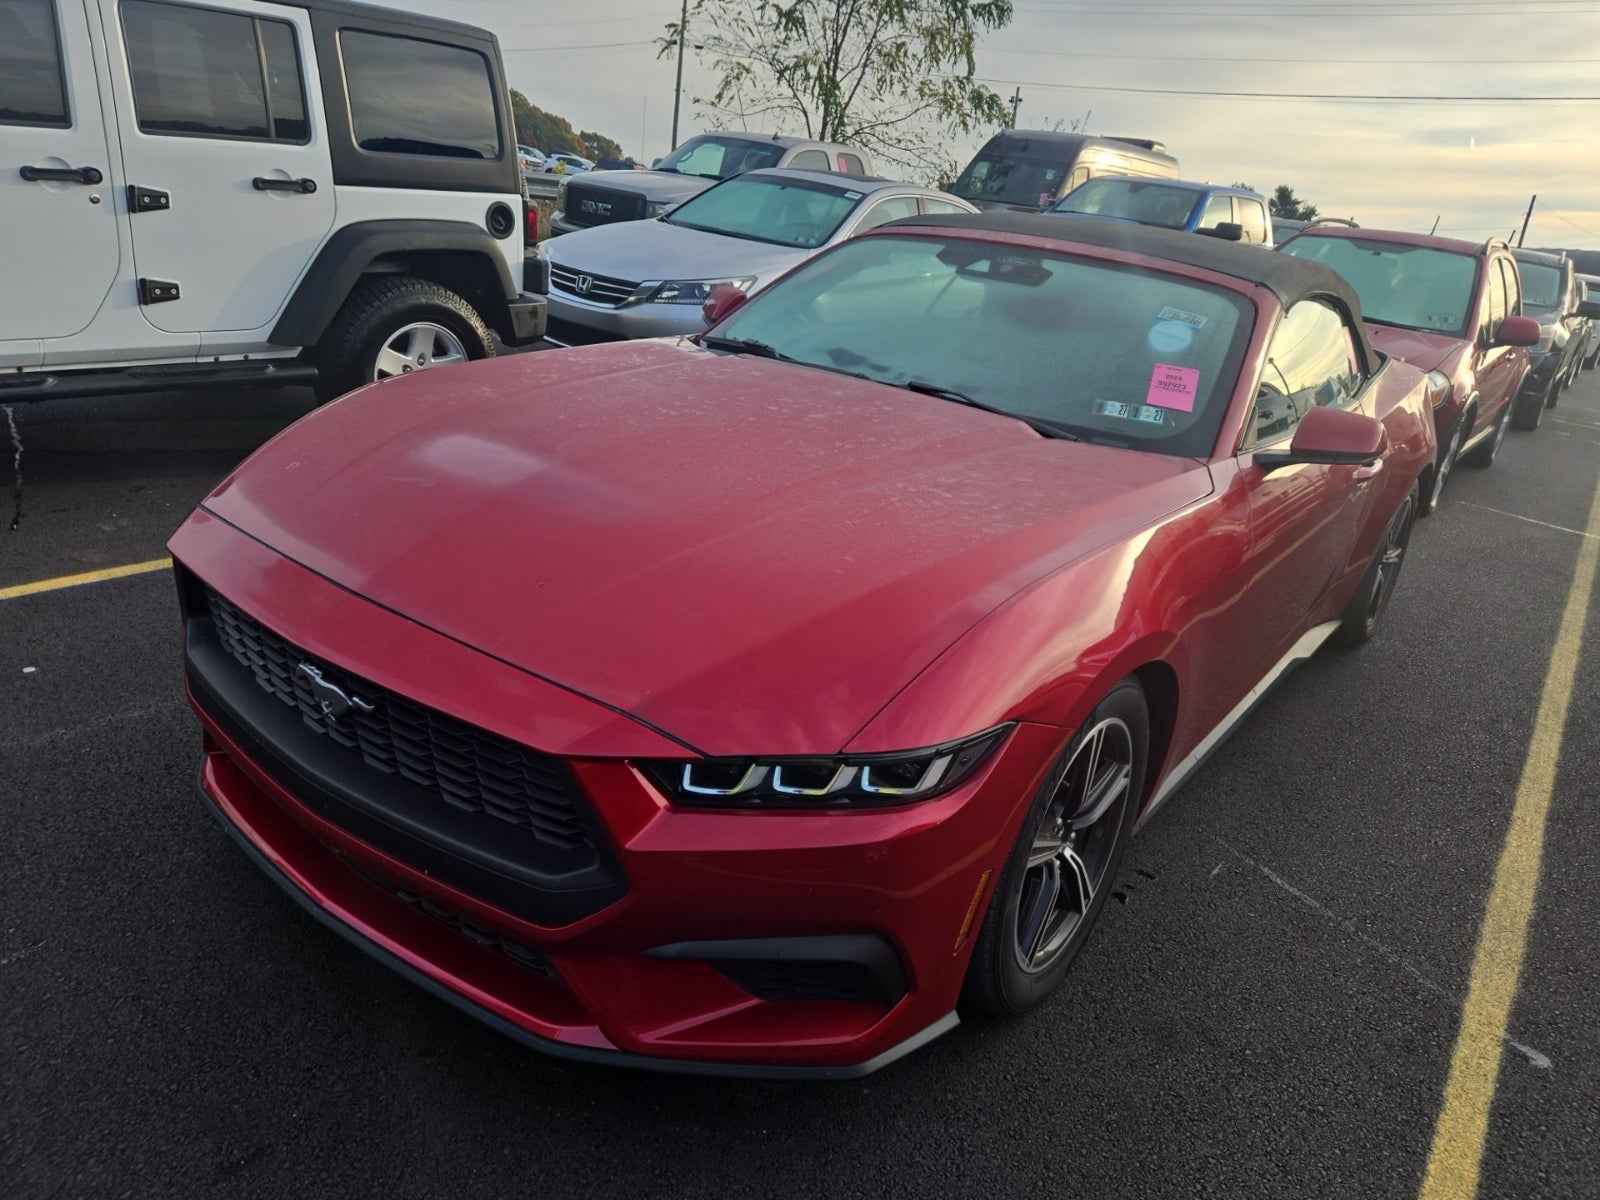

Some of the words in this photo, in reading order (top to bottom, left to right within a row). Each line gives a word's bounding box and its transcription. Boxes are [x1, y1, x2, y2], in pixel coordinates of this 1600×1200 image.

[581, 199, 612, 216] GMC
[1165, 373, 1183, 381] 2024
[1153, 409, 1163, 422] 27
